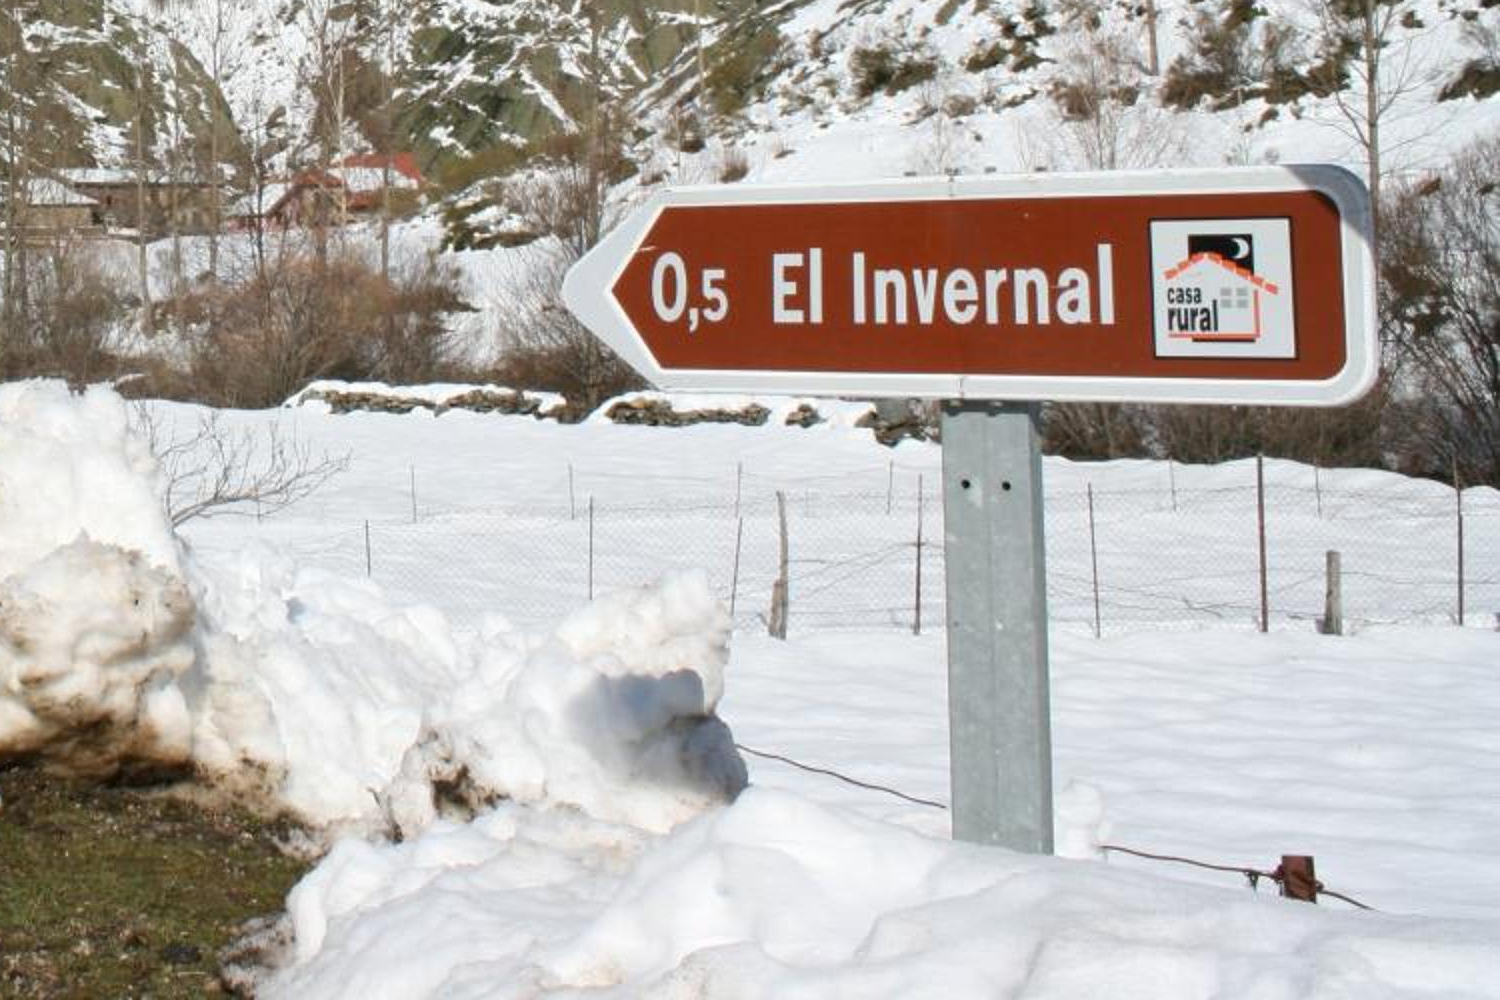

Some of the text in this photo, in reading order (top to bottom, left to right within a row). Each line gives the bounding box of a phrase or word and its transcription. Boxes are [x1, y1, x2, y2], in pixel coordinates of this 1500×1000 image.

[652, 244, 1115, 332] 0,5 El Invernal
[1167, 287, 1202, 304] casa
[1168, 299, 1218, 332] rural
